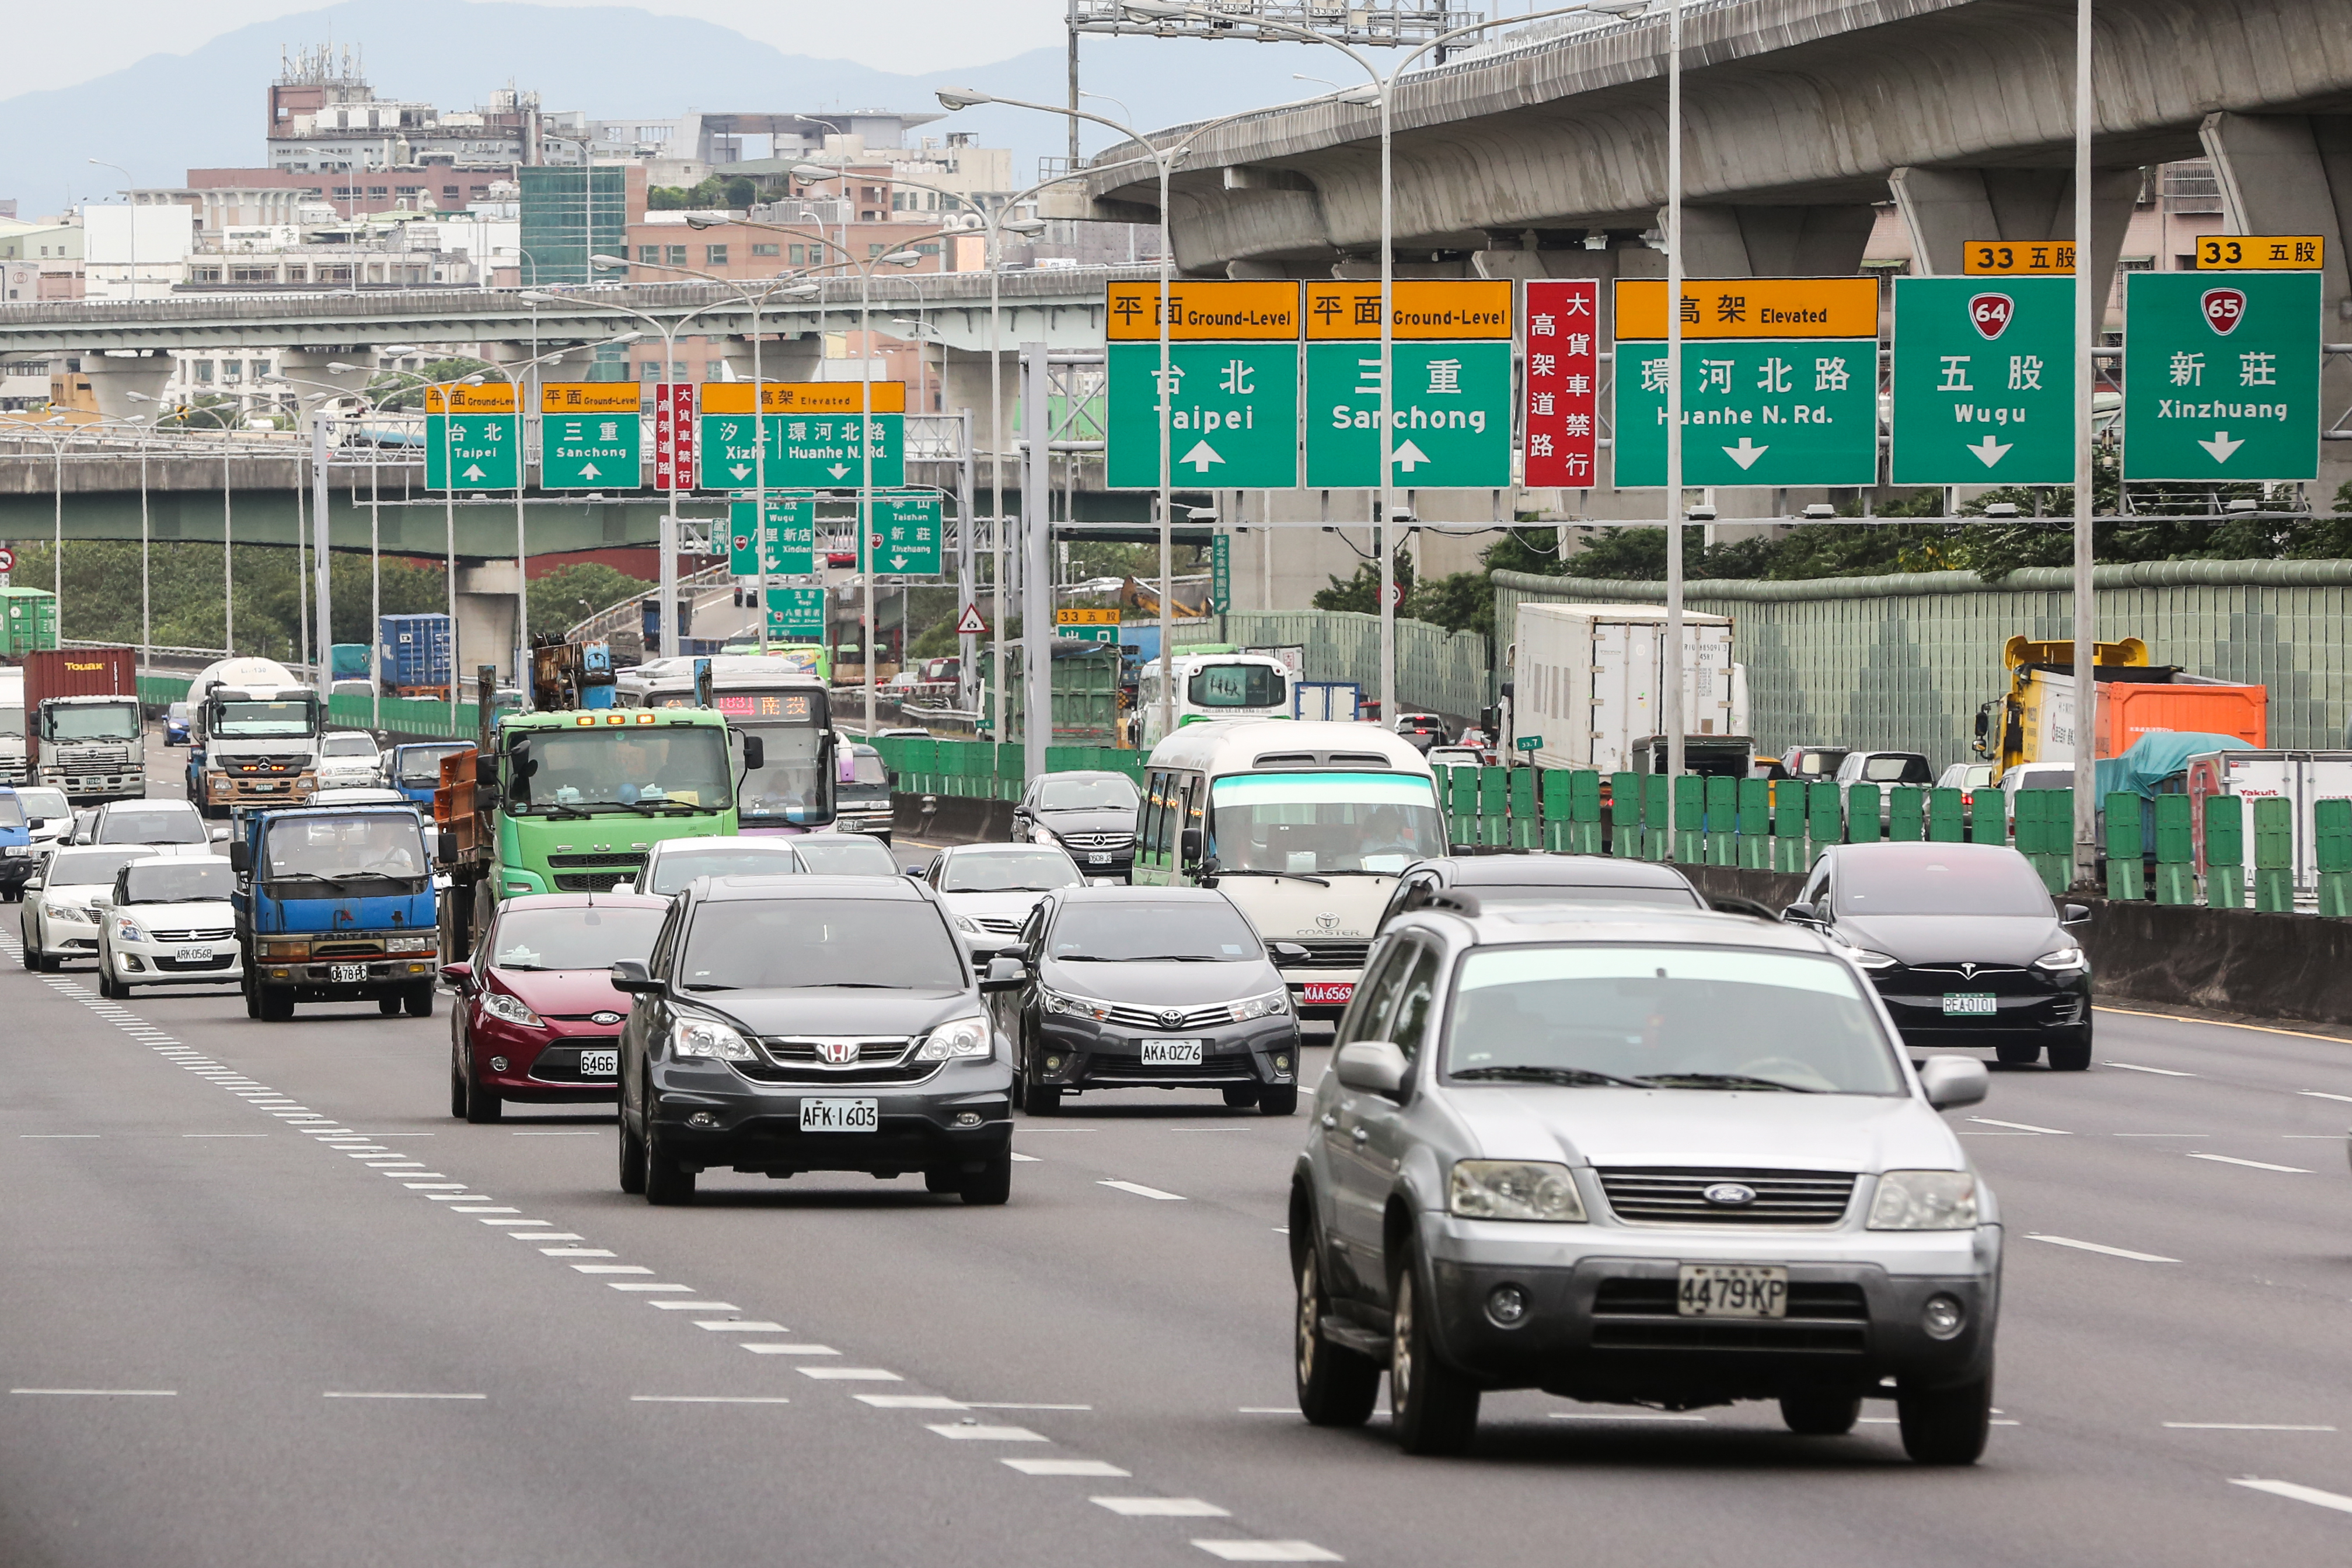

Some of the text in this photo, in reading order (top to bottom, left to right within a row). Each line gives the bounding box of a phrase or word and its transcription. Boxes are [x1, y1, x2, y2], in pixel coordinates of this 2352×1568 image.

[1977, 247, 2076, 269] 33 五股
[2204, 242, 2316, 264] 33 五股
[1114, 296, 1290, 326] 平面 Ground-Level
[1314, 296, 1505, 326] 平面 Ground-Level
[1680, 295, 1827, 323] 高架 Elevated
[1975, 303, 2006, 323] 64
[2208, 299, 2239, 318] 65
[1151, 359, 1255, 394] 台北
[1355, 358, 1461, 394] 三重
[1641, 357, 1850, 394] 環河北路
[1937, 355, 2043, 392] 五股
[2169, 351, 2276, 387] 新莊
[1531, 313, 1555, 458] 高架道路
[1566, 293, 1590, 477] 大貨車禁行
[430, 390, 465, 406] 平面
[546, 390, 636, 406] 平面 Ground-Level
[761, 391, 793, 404] 高架
[1332, 405, 1486, 434] Sanchong
[1657, 405, 1833, 425] Huanhe N. Rd.
[1955, 404, 2025, 425] Wugu
[2158, 400, 2287, 421] Xinzhuang
[449, 424, 502, 442] 台北
[564, 422, 618, 441] 三重
[658, 400, 669, 474] 高架道路
[678, 389, 691, 483] 大貨車禁行
[788, 422, 885, 441] 環河北路
[455, 448, 496, 458] Taipei
[557, 447, 626, 458] Sanchong
[726, 446, 766, 459] Xizhi
[789, 446, 887, 459] Huanhe N. Rd.
[769, 514, 794, 523] Wugu
[783, 528, 811, 542] 新店
[891, 526, 930, 540] 新莊
[892, 545, 930, 554] Xinzhuang
[1061, 612, 1116, 621] 33 五股
[760, 696, 807, 715] 南投
[557, 843, 648, 853] FUS
[177, 949, 212, 959] ARK-0568
[1305, 987, 1352, 1000] KAA-6569
[1945, 998, 1993, 1012] REA-0101
[1143, 1046, 1201, 1060] AKA-0276
[582, 1056, 616, 1071] 6466-
[802, 1107, 875, 1126] AFK-1603
[1681, 1278, 1786, 1309] 4479-KP
